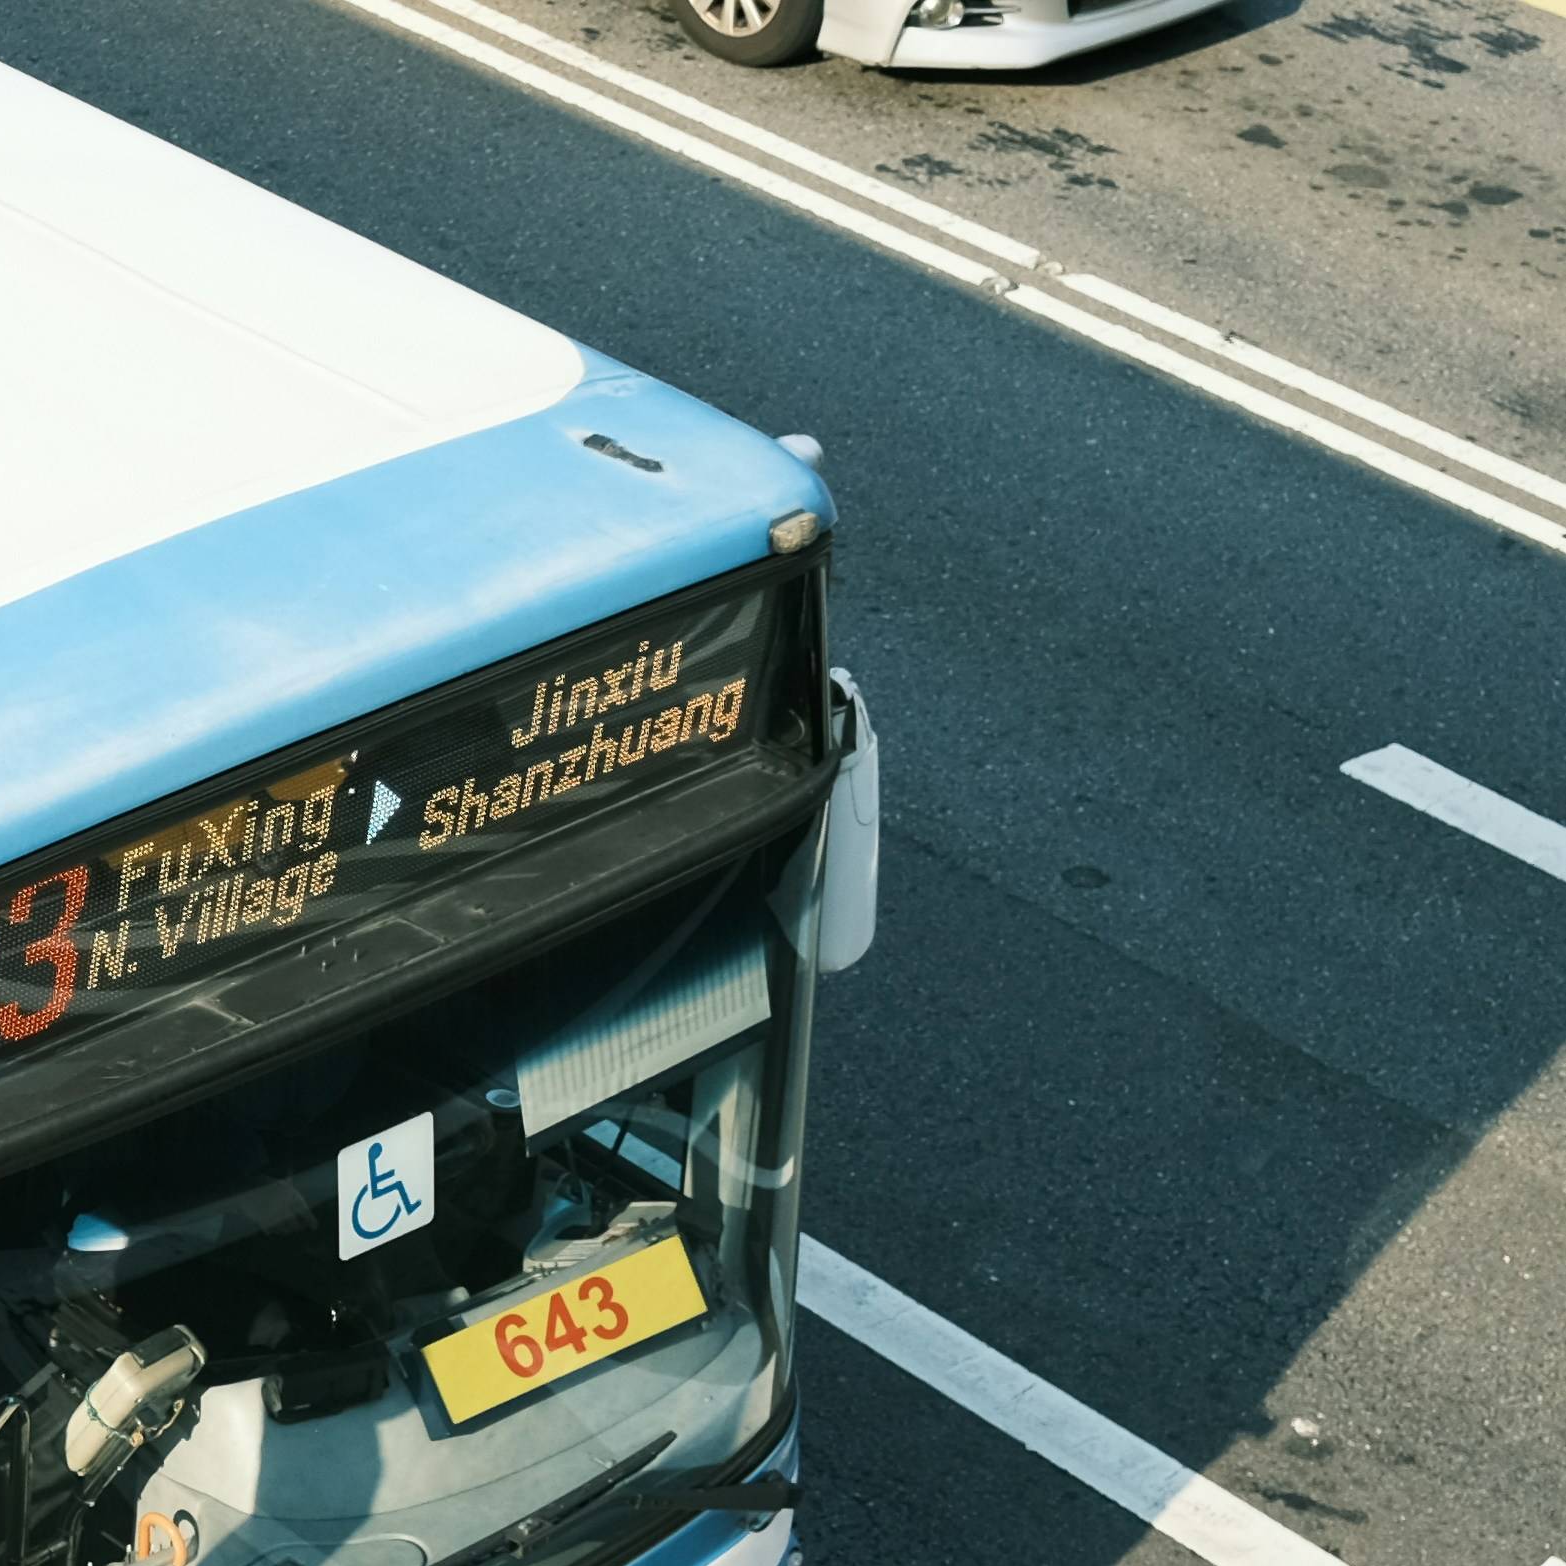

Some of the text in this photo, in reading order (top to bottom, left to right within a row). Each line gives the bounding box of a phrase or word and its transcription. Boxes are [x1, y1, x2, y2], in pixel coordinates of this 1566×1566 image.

[510, 640, 684, 750] Jinxiu
[418, 677, 747, 852] Shanzhuang
[117, 784, 336, 912] FuXing
[87, 851, 340, 990] N. Village
[494, 1276, 629, 1379] 643
